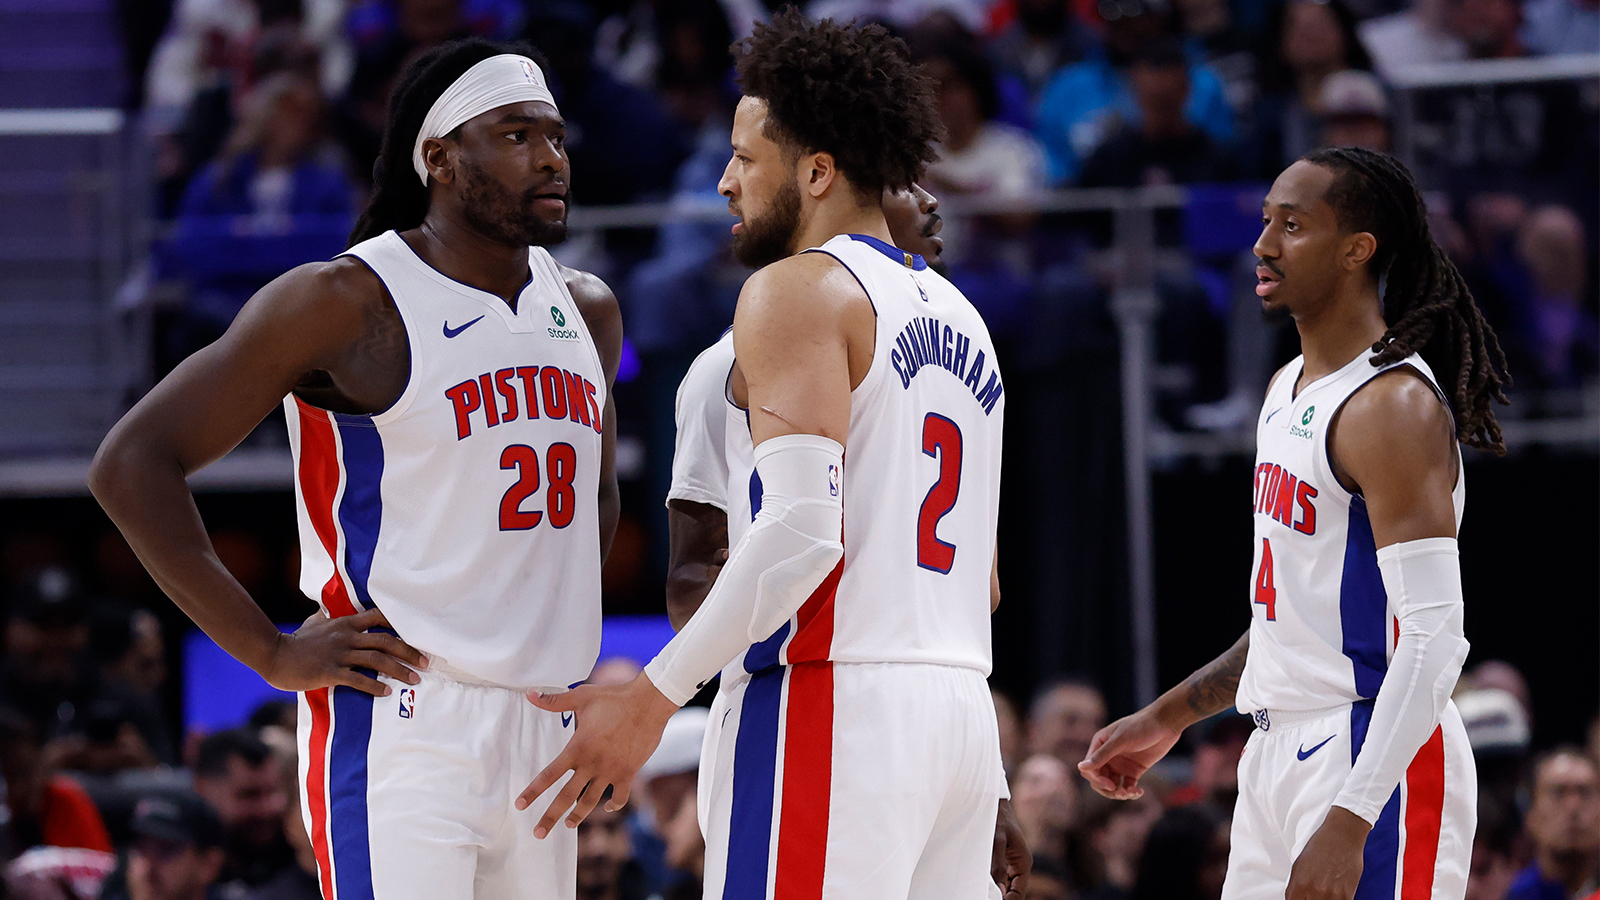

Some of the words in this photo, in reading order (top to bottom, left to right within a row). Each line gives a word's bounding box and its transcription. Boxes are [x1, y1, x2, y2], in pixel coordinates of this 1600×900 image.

[547, 327, 580, 340] StockX
[891, 317, 1003, 416] CUNNINGHAM
[445, 365, 602, 441] PISTONS
[499, 442, 576, 531] 28
[917, 412, 963, 575] 2
[1253, 463, 1318, 536] STONS
[1251, 537, 1276, 621] 4
